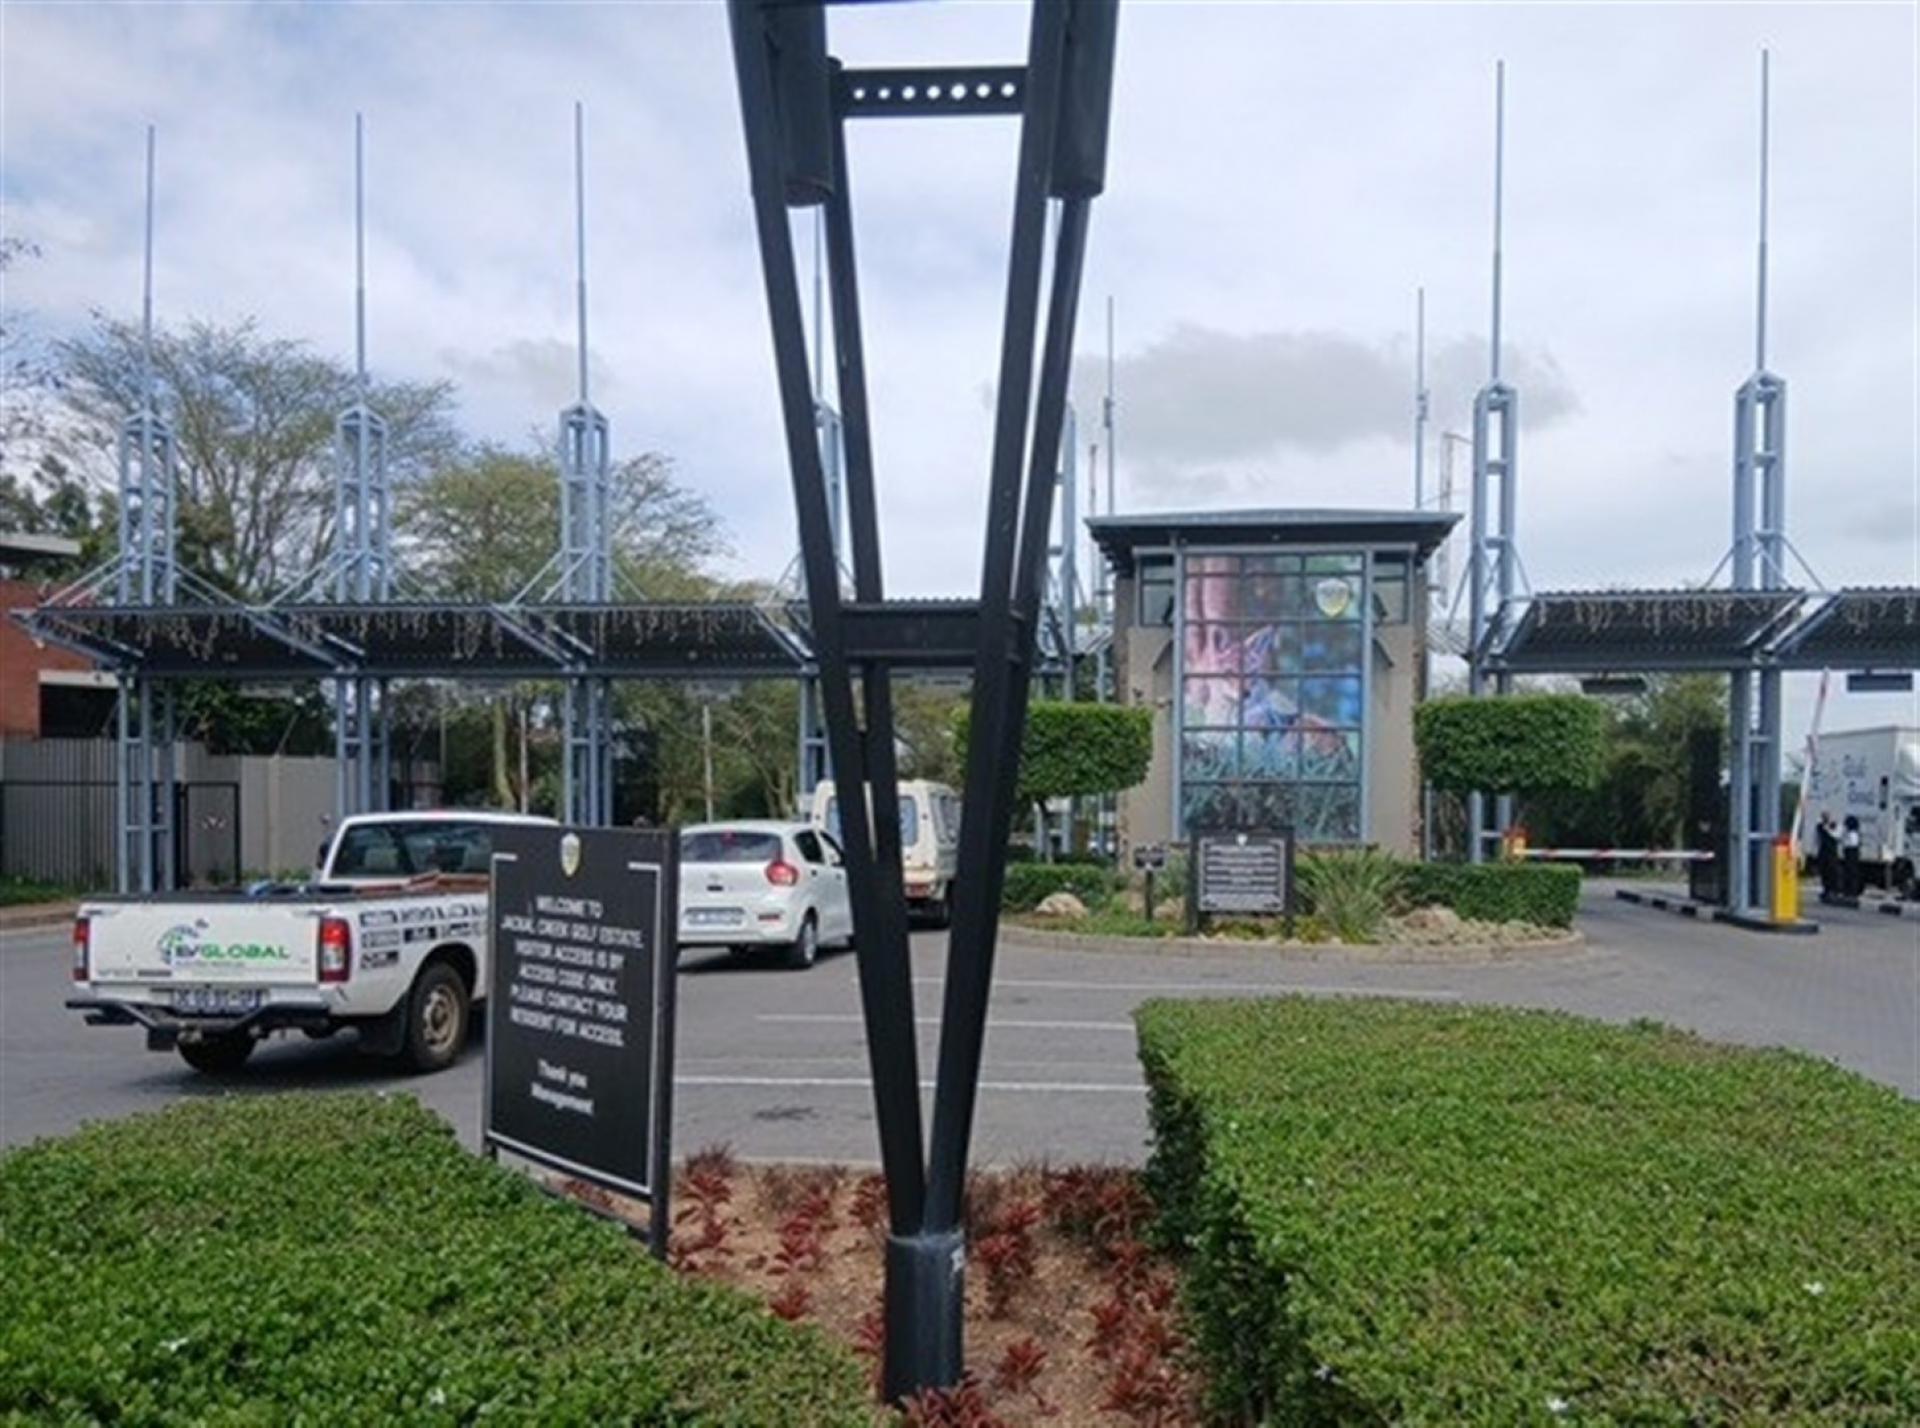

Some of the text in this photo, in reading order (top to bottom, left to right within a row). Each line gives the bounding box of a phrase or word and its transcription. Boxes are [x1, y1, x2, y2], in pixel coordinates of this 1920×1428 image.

[537, 896, 604, 919] WELCOME TO
[571, 923, 597, 943] GOLF
[554, 946, 594, 966] ACCESS
[597, 951, 607, 969] IS
[597, 1000, 628, 1022] YOUR
